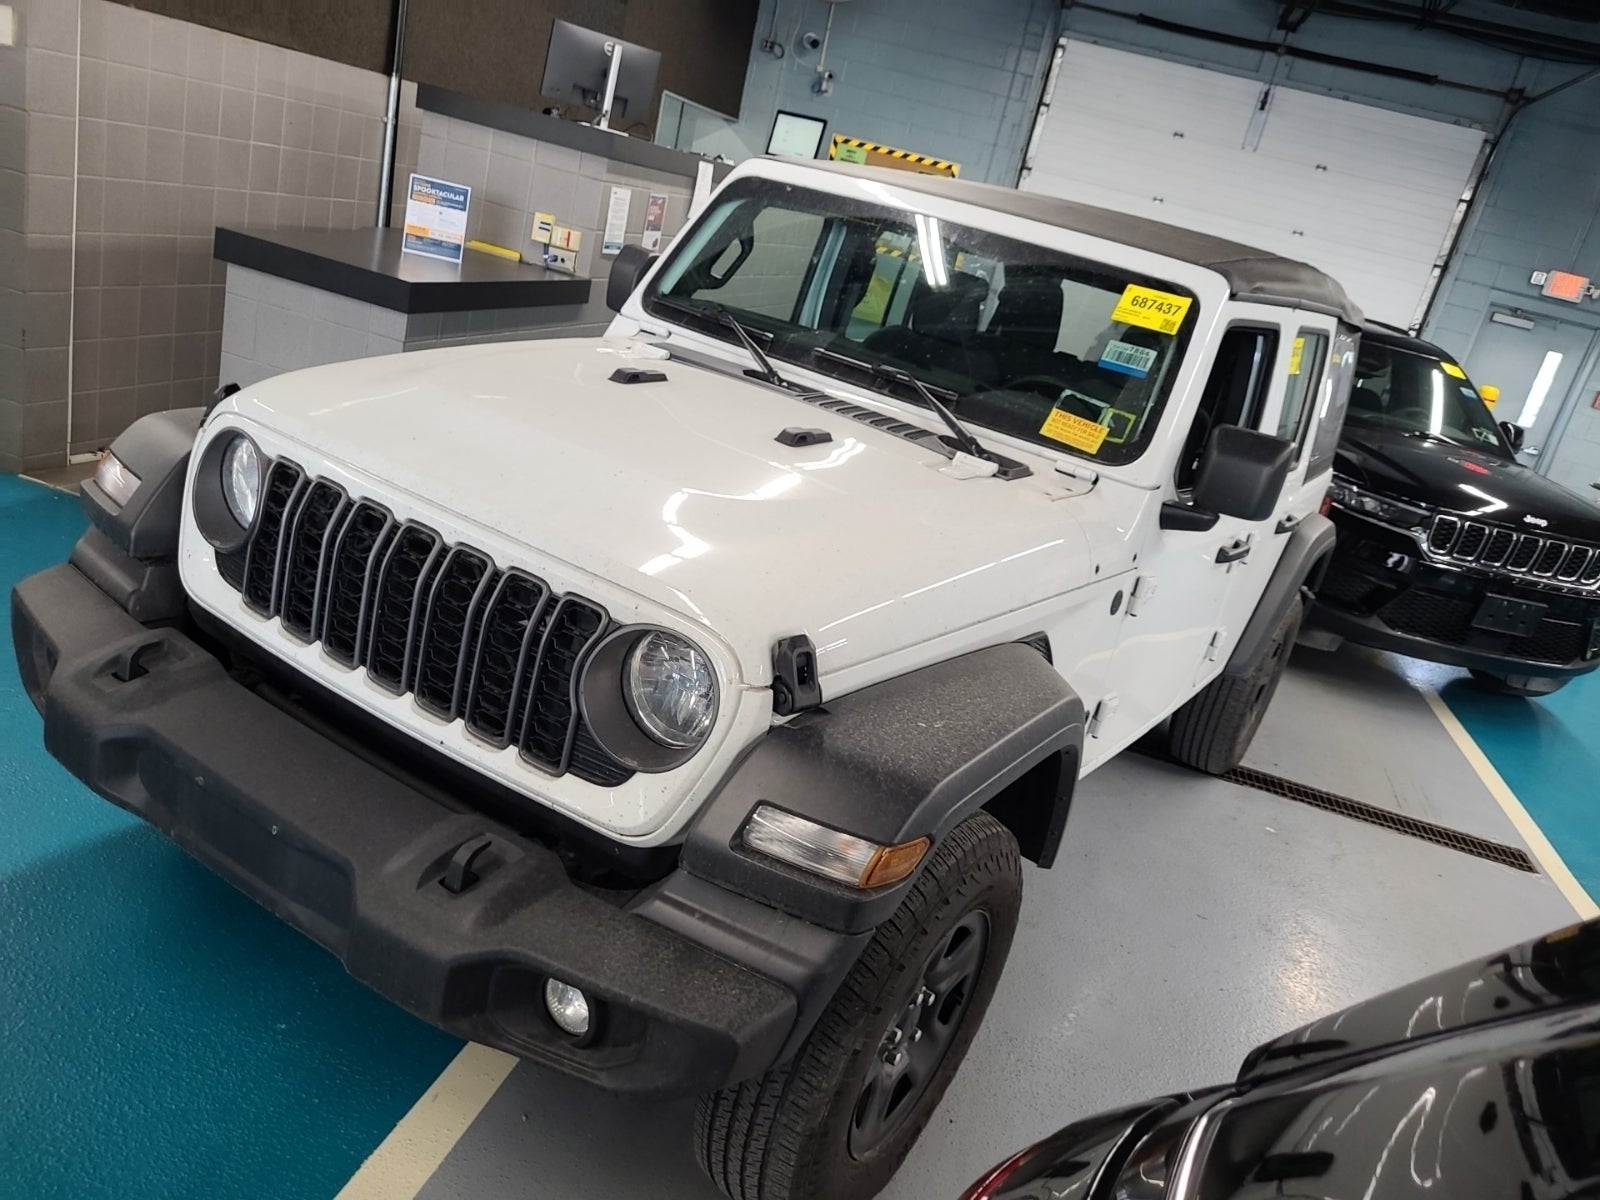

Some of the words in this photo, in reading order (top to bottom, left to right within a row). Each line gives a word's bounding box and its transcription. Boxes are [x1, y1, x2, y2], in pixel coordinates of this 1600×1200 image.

[413, 184, 464, 201] SPOOKTACULAR
[1131, 295, 1182, 316] 687437
[1054, 411, 1072, 422] THIS
[1072, 417, 1104, 433] VEHICLE
[1523, 515, 1548, 528] Jeep
